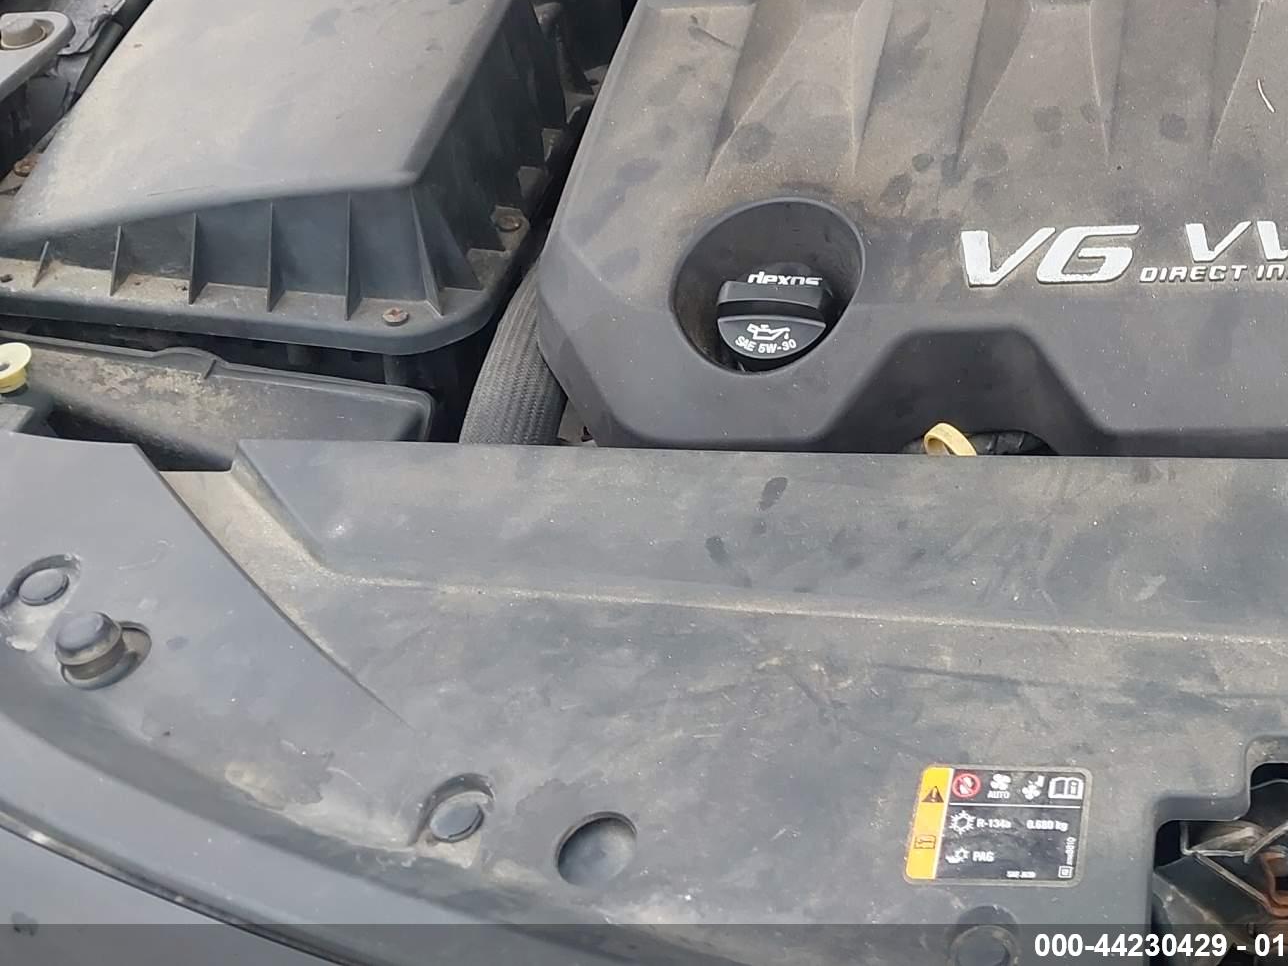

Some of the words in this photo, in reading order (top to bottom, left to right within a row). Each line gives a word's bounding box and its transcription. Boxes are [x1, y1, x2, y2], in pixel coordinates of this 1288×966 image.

[960, 224, 1140, 288] V6
[1138, 263, 1248, 282] DIRECT
[734, 336, 757, 352] SAE
[757, 339, 797, 354] 5W-30
